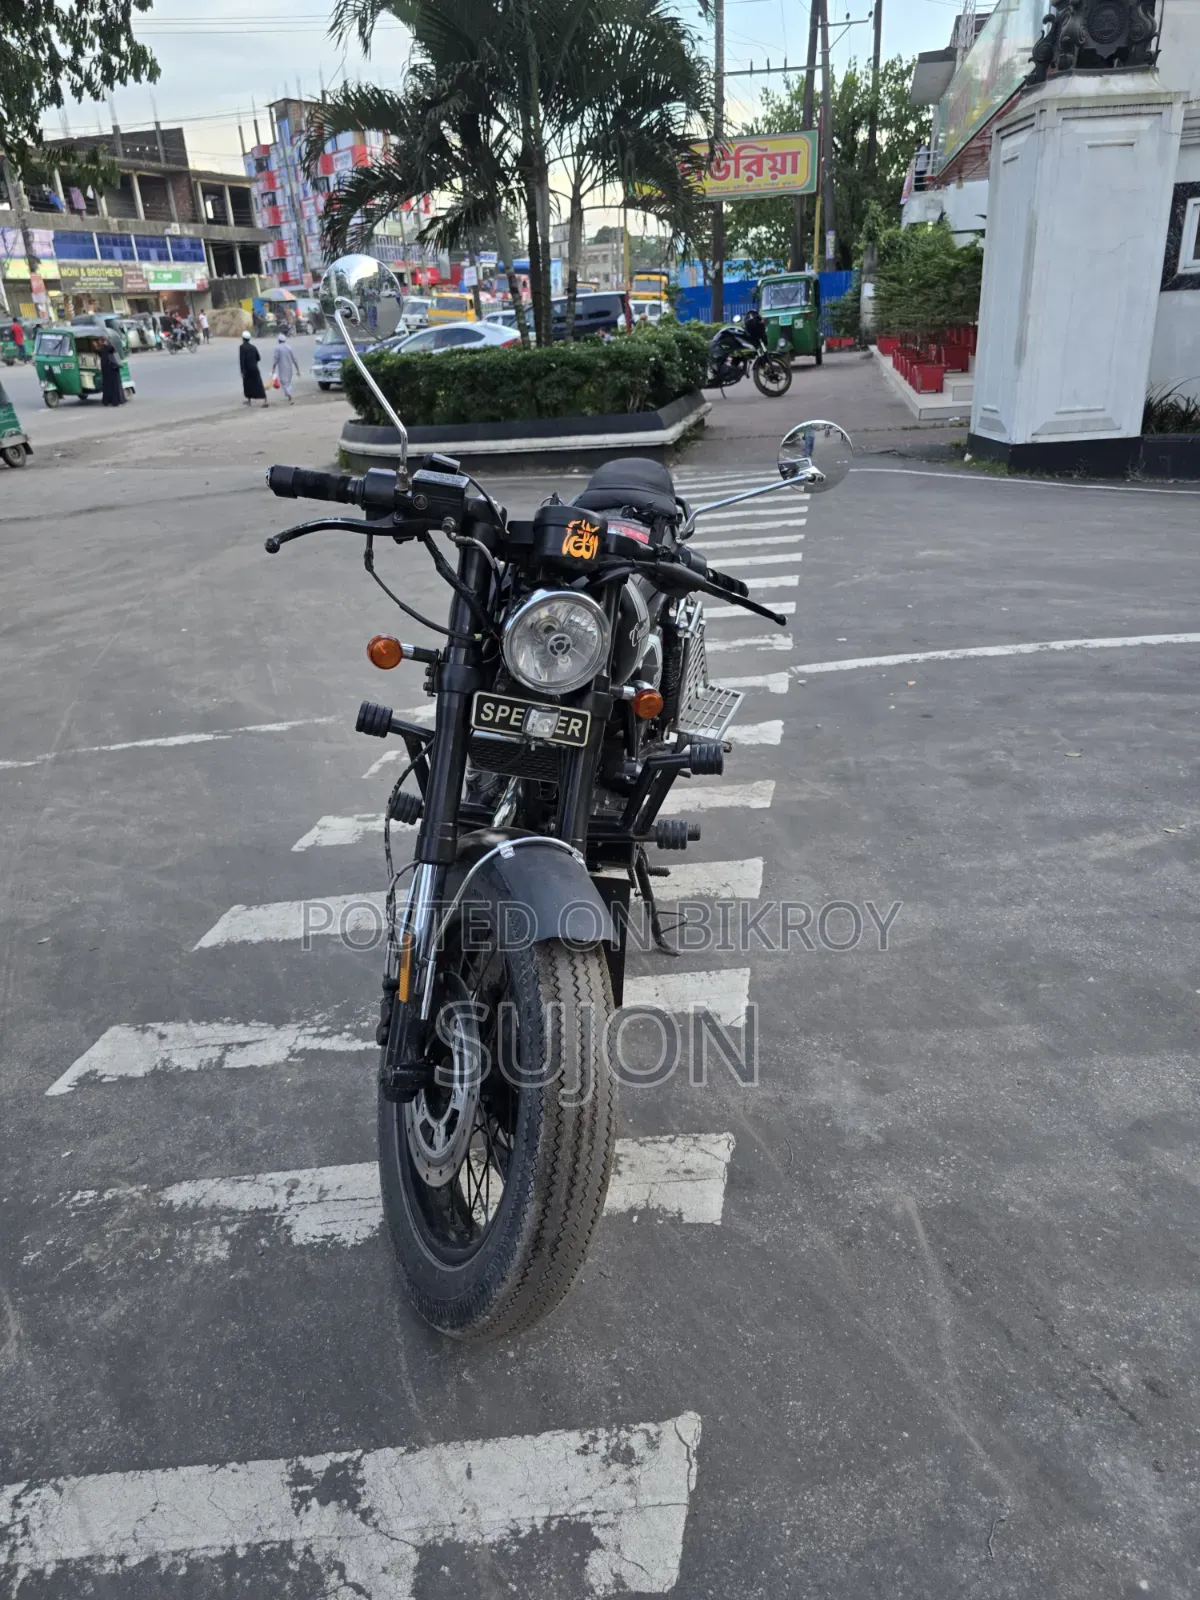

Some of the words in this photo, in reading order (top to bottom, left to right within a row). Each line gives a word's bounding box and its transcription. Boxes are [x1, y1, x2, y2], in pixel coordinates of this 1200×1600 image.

[80, 267, 87, 277] &
[86, 267, 123, 278] BROTHERS
[480, 702, 583, 738] SPEER
